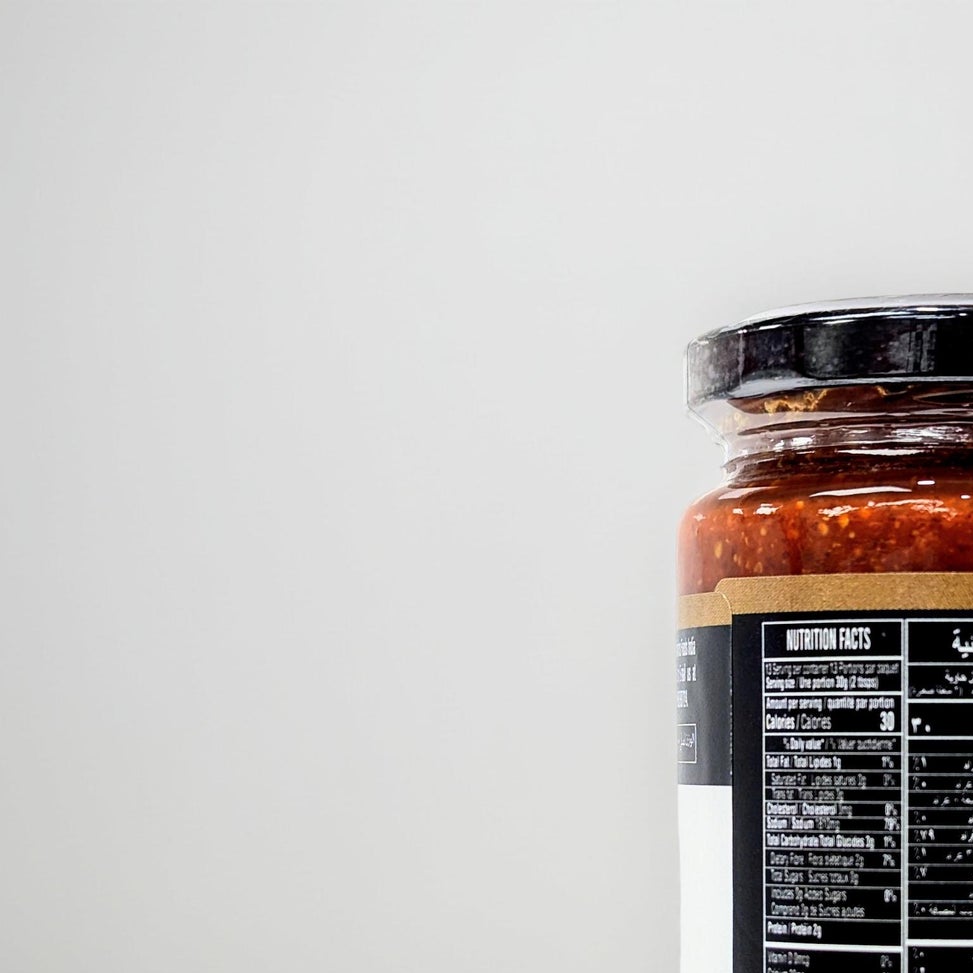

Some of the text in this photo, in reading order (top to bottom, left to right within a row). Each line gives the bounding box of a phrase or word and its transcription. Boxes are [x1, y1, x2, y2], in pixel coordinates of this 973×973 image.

[786, 627, 871, 651] NUTRITION FACTS
[766, 713, 795, 730] Calories
[880, 711, 895, 731] 30
